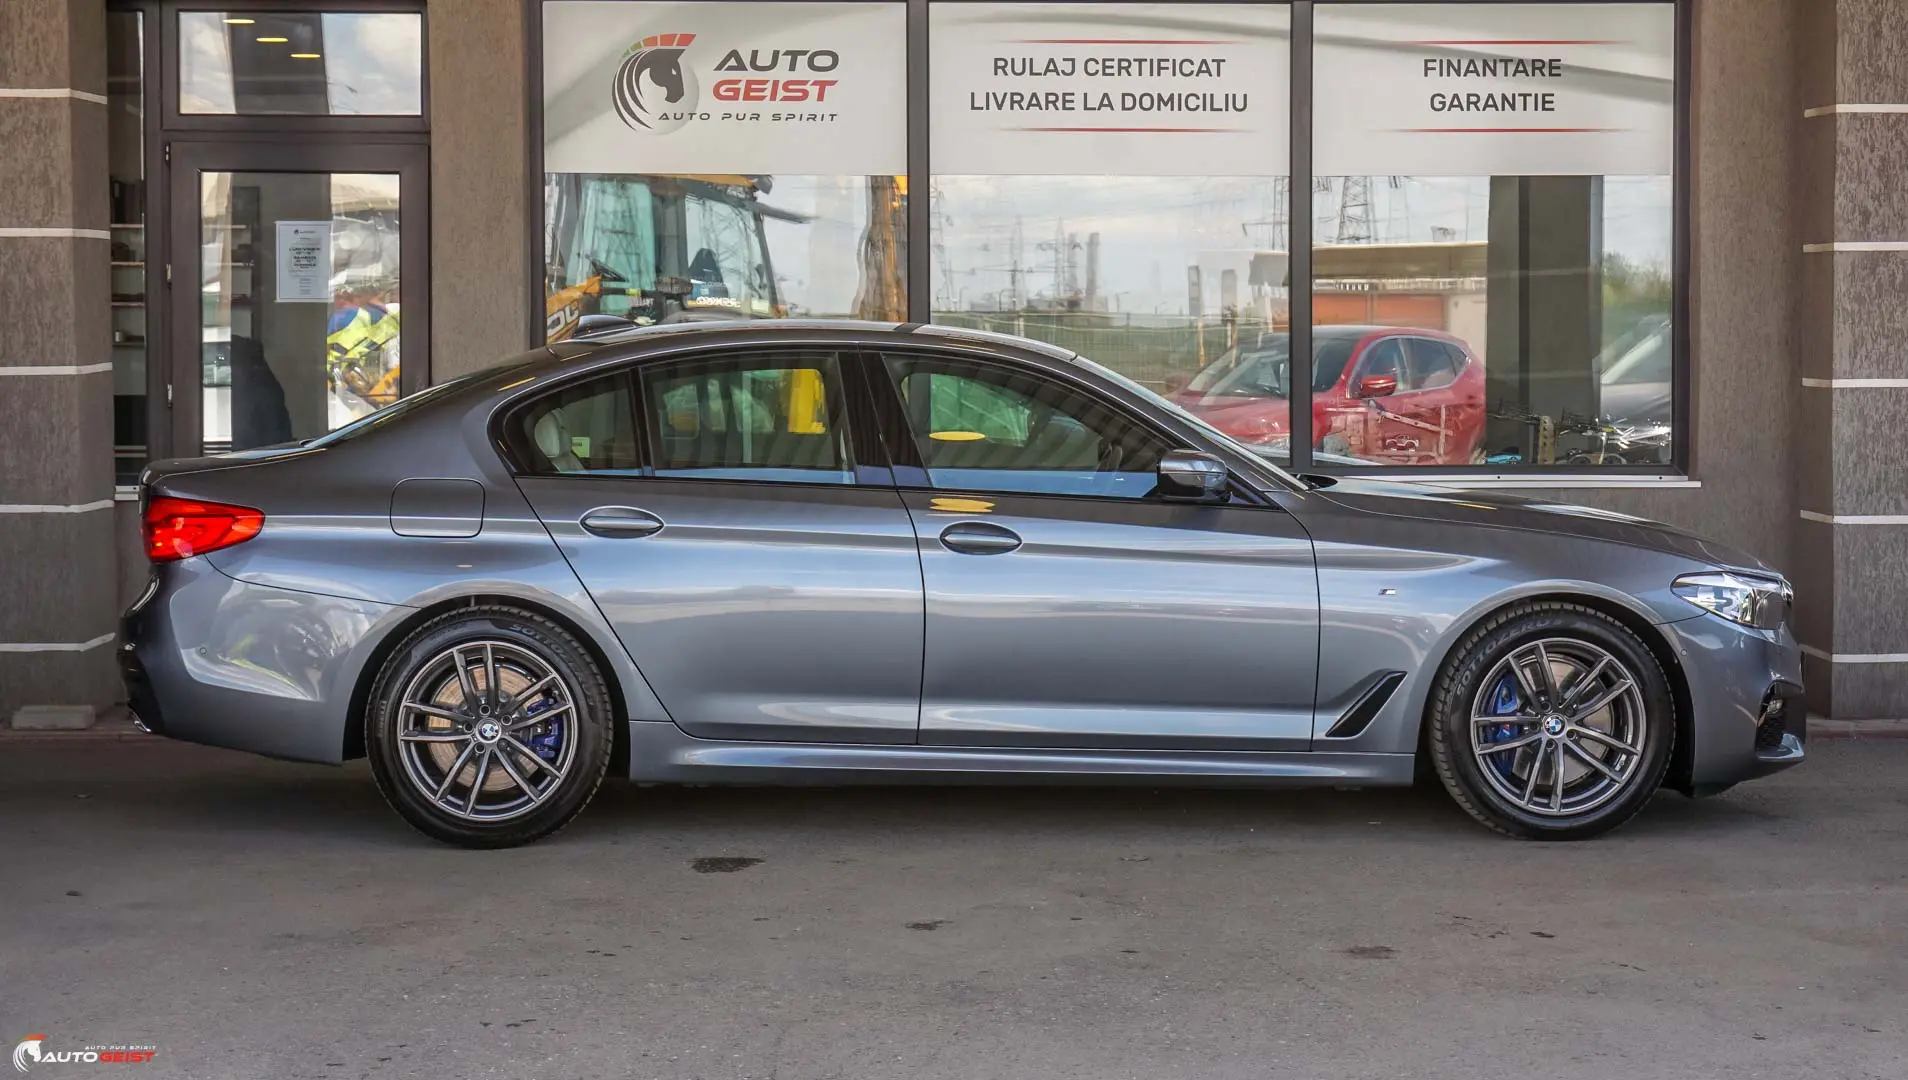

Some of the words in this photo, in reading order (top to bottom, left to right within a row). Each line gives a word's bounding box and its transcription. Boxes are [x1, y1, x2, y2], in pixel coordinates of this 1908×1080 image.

[713, 49, 840, 73] AUTO
[993, 57, 1076, 77] RULAJ
[1083, 57, 1226, 78] CERTIFICAT
[1423, 58, 1562, 78] FINANTARE
[712, 79, 839, 102] GEIST
[970, 91, 1076, 111] LIVRARE
[1083, 92, 1115, 111] LA
[1121, 92, 1248, 113] DOMICILIU
[1430, 92, 1555, 112] GARANTIE
[658, 112, 711, 121] AUTO
[721, 112, 761, 122] PUR
[771, 113, 838, 122] SPIRIT
